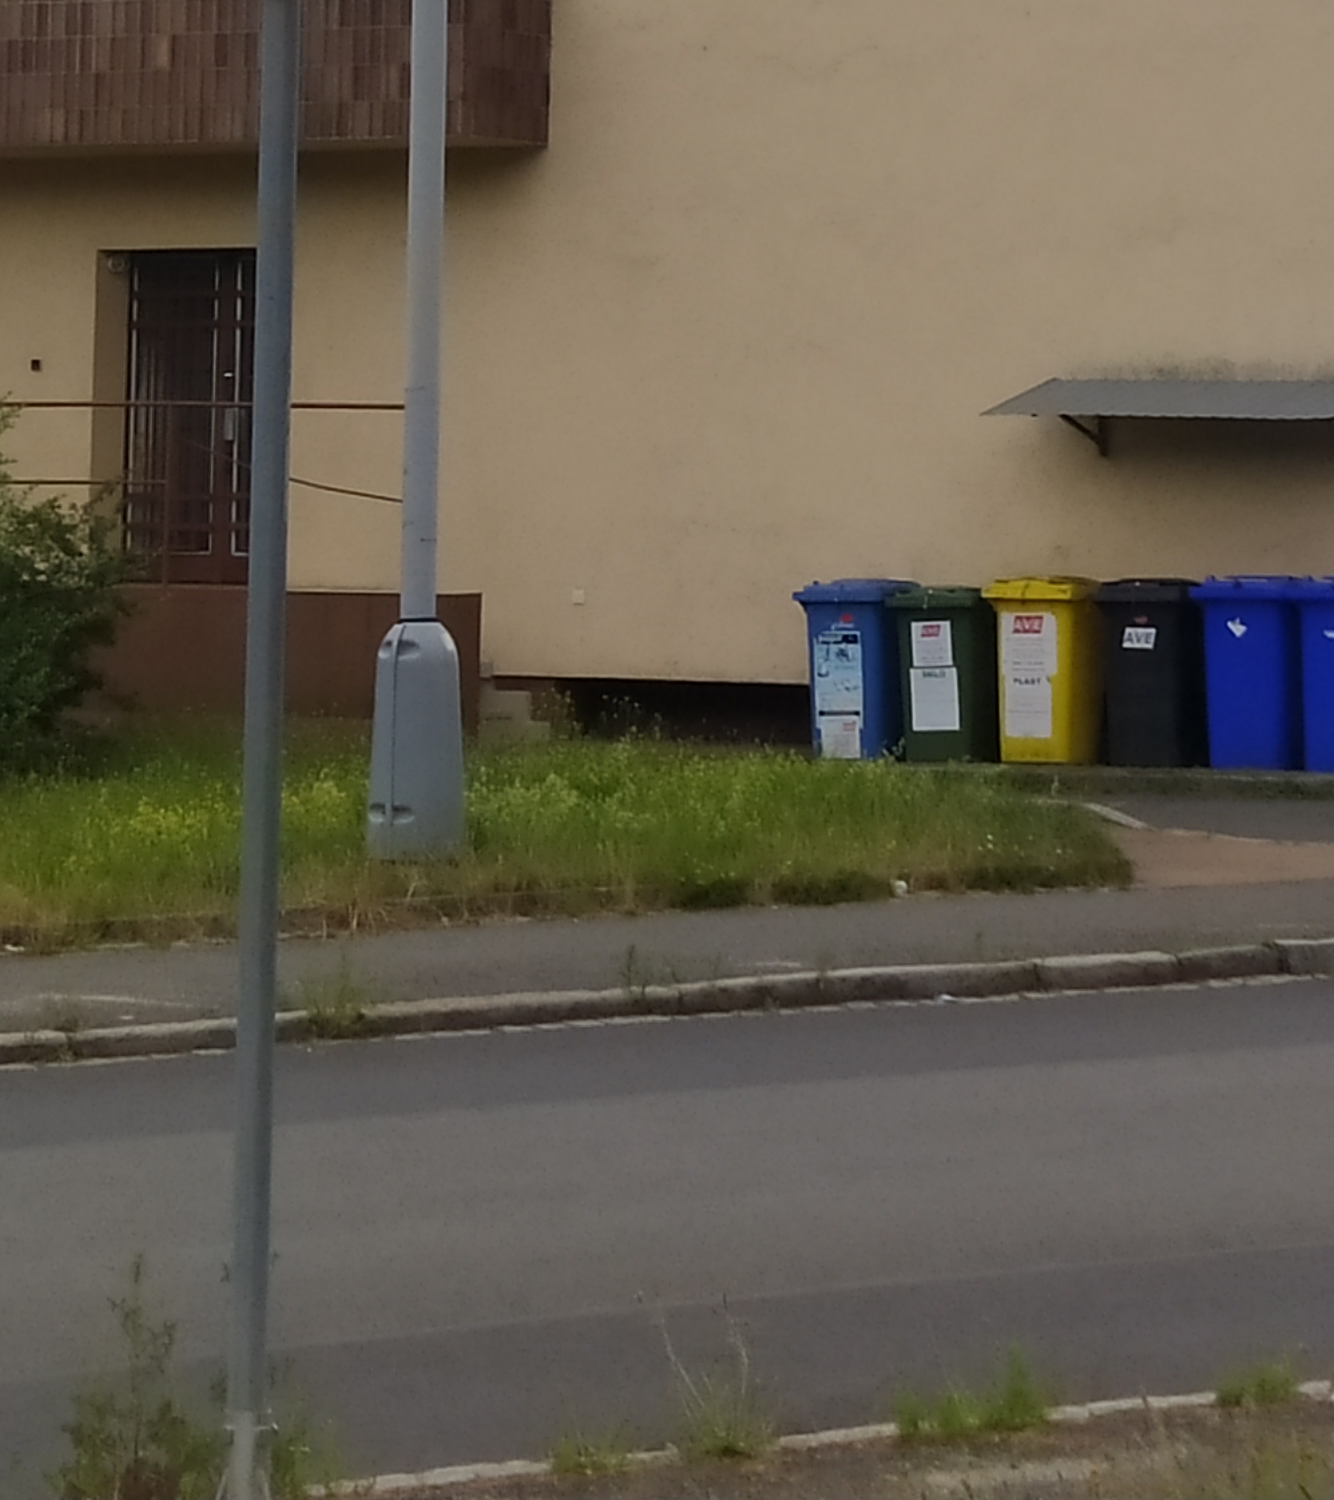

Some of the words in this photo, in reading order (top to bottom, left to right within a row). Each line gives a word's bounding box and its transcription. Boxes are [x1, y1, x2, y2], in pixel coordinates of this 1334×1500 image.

[1014, 617, 1043, 632] AVE
[1123, 631, 1153, 645] AVE
[1013, 677, 1042, 686] PLAST
